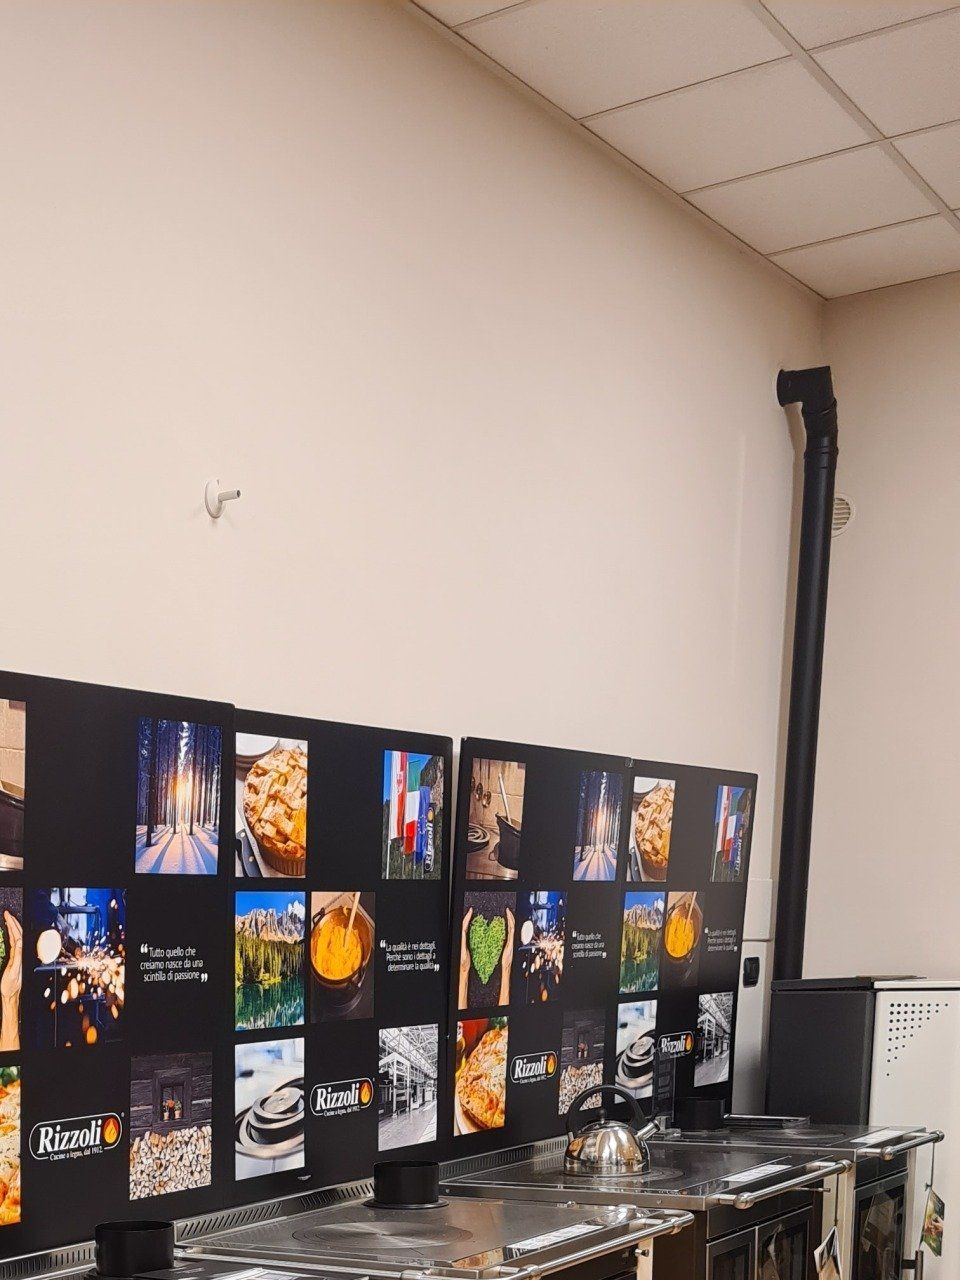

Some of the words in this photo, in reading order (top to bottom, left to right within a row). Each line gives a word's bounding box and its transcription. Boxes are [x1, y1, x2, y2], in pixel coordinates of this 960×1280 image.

[149, 946, 165, 958] Tutto
[166, 946, 184, 959] quello
[185, 946, 197, 957] che
[140, 958, 164, 971] creiamo
[165, 960, 183, 969] nasce
[184, 958, 191, 968] da
[192, 959, 204, 968] una
[143, 970, 166, 982] scintilla
[167, 970, 173, 981] di
[174, 969, 200, 983] passione
[514, 1055, 547, 1079] Rizzoli
[315, 1083, 360, 1111] Rizzoli
[37, 1119, 102, 1155] Rizzoli
[49, 1152, 66, 1161] Cucine
